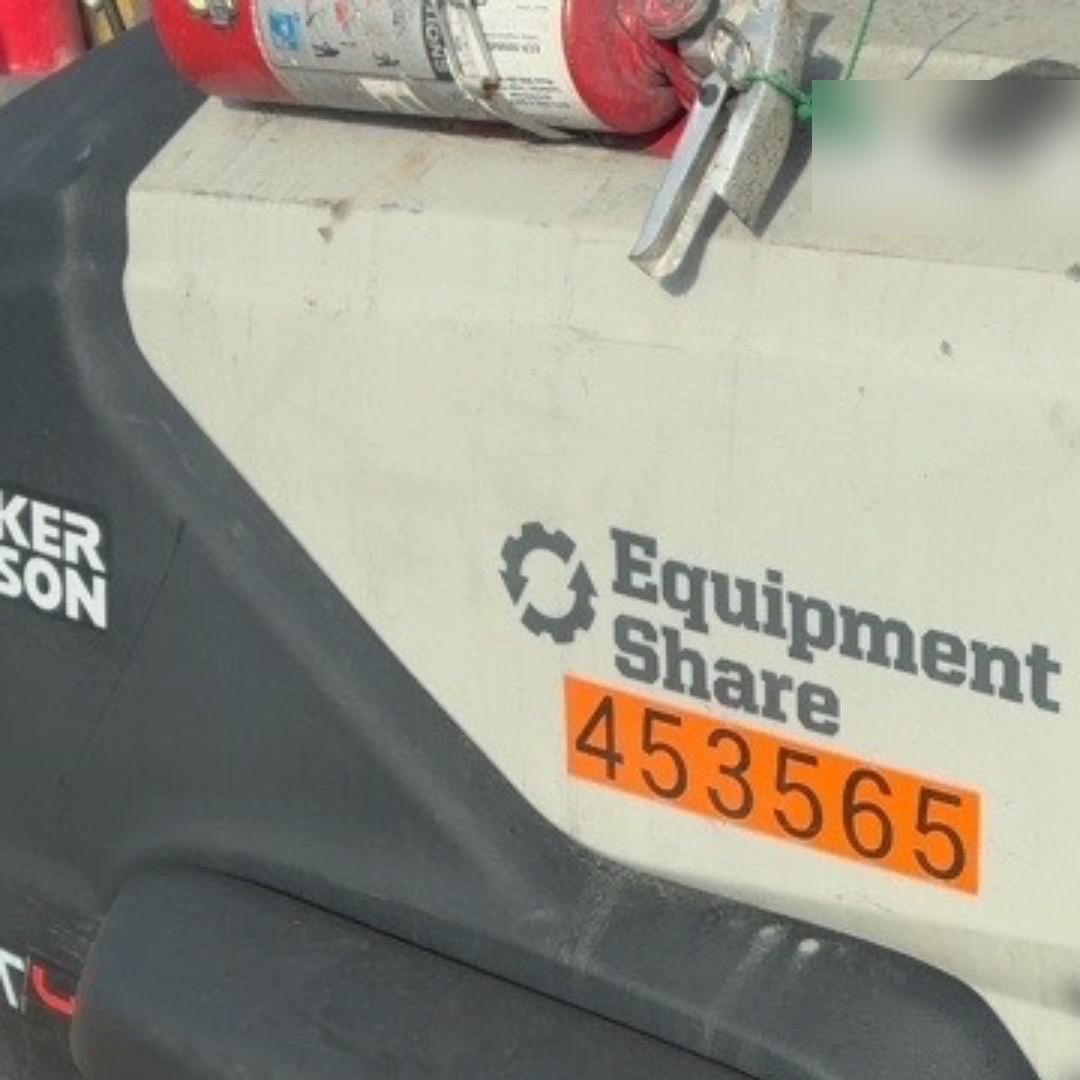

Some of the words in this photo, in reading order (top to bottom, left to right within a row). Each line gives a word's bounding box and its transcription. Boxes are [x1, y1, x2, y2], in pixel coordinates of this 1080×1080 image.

[610, 526, 1061, 713] Equipment
[613, 614, 840, 737] Share
[575, 695, 966, 881] 453565
